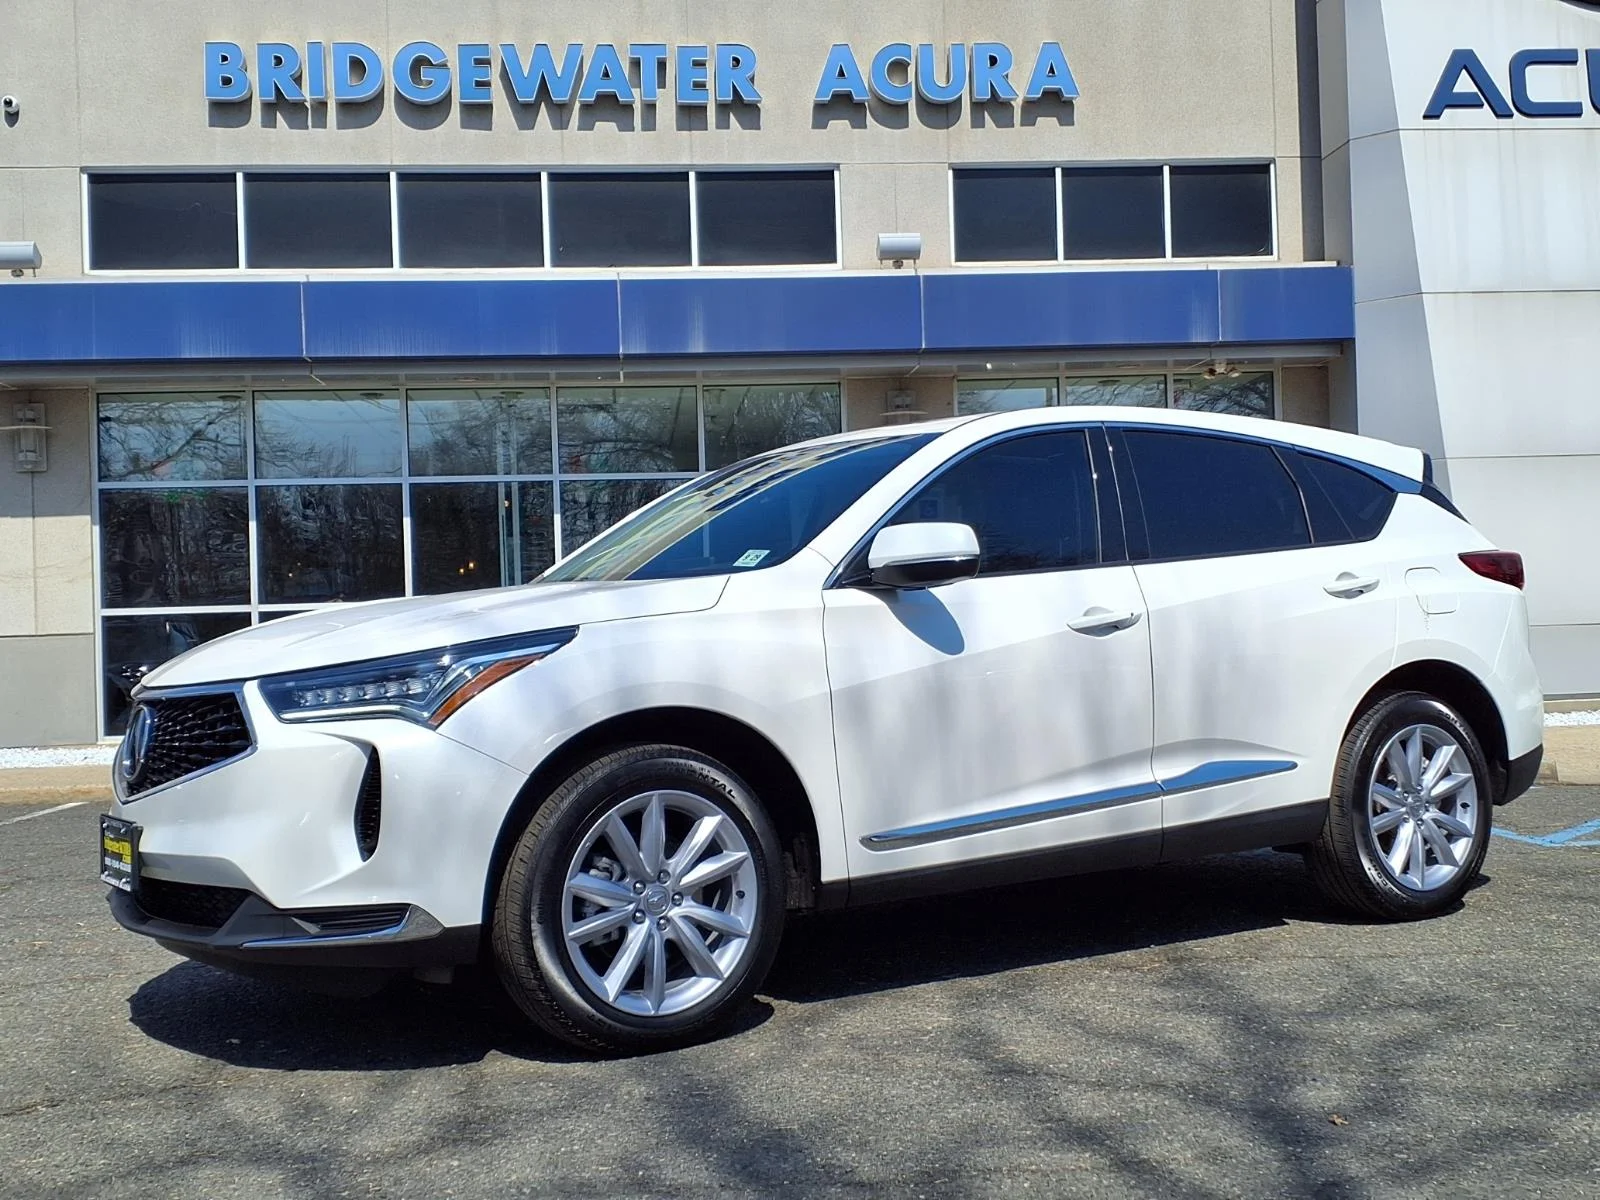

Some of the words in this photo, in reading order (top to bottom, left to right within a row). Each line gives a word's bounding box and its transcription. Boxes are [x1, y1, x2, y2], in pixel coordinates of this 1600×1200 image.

[204, 40, 762, 105] BRIDGEWATER
[814, 41, 1080, 105] ACURA
[1422, 48, 1600, 119] AC
